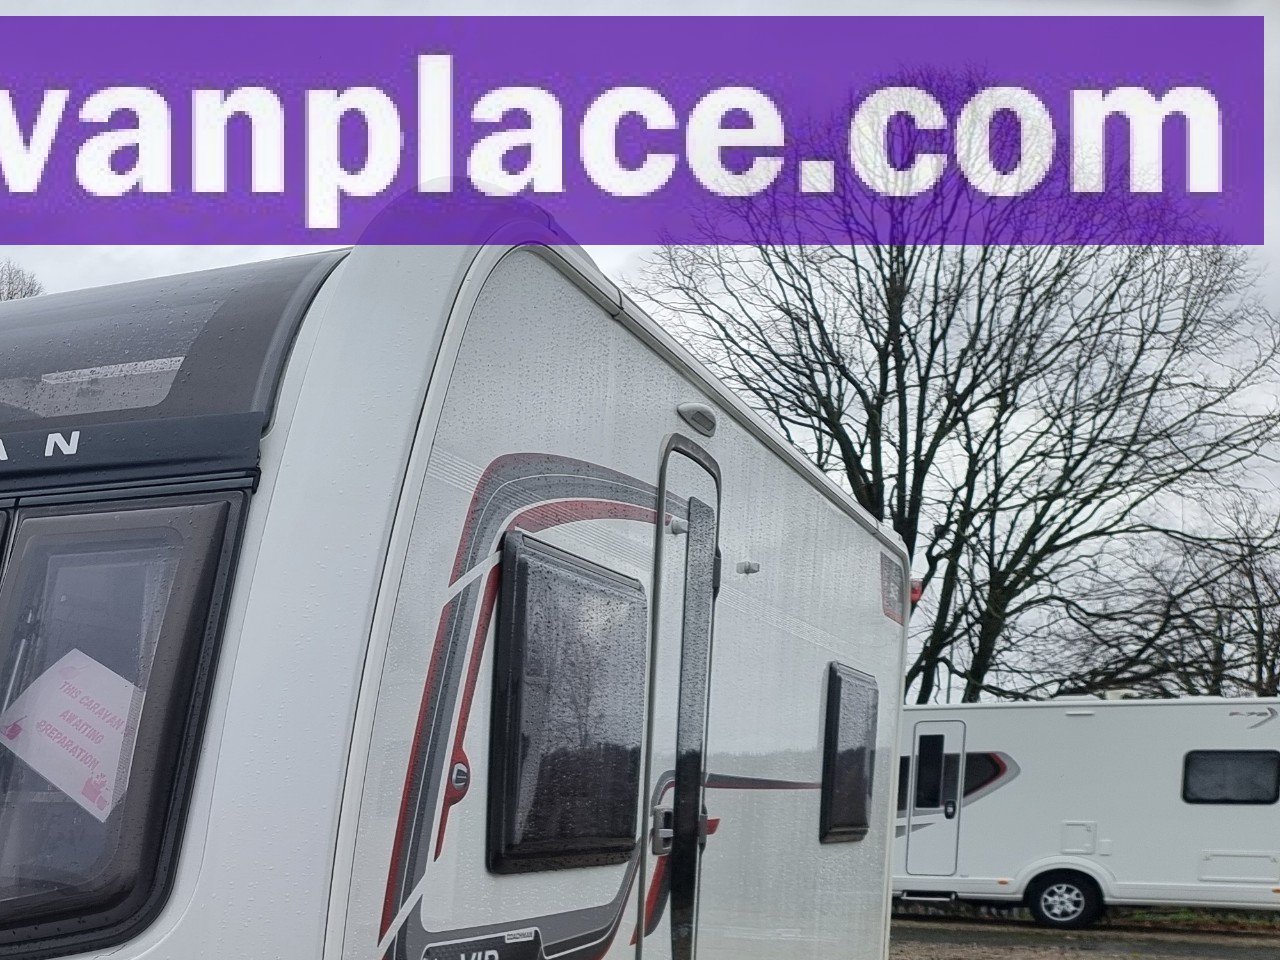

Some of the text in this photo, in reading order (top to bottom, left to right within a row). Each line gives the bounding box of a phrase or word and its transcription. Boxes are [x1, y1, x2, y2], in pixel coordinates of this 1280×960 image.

[58, 681, 81, 700] THIS
[79, 694, 126, 731] CARAVAN
[59, 709, 105, 745] AWAITING
[36, 719, 100, 771] PREPARATION
